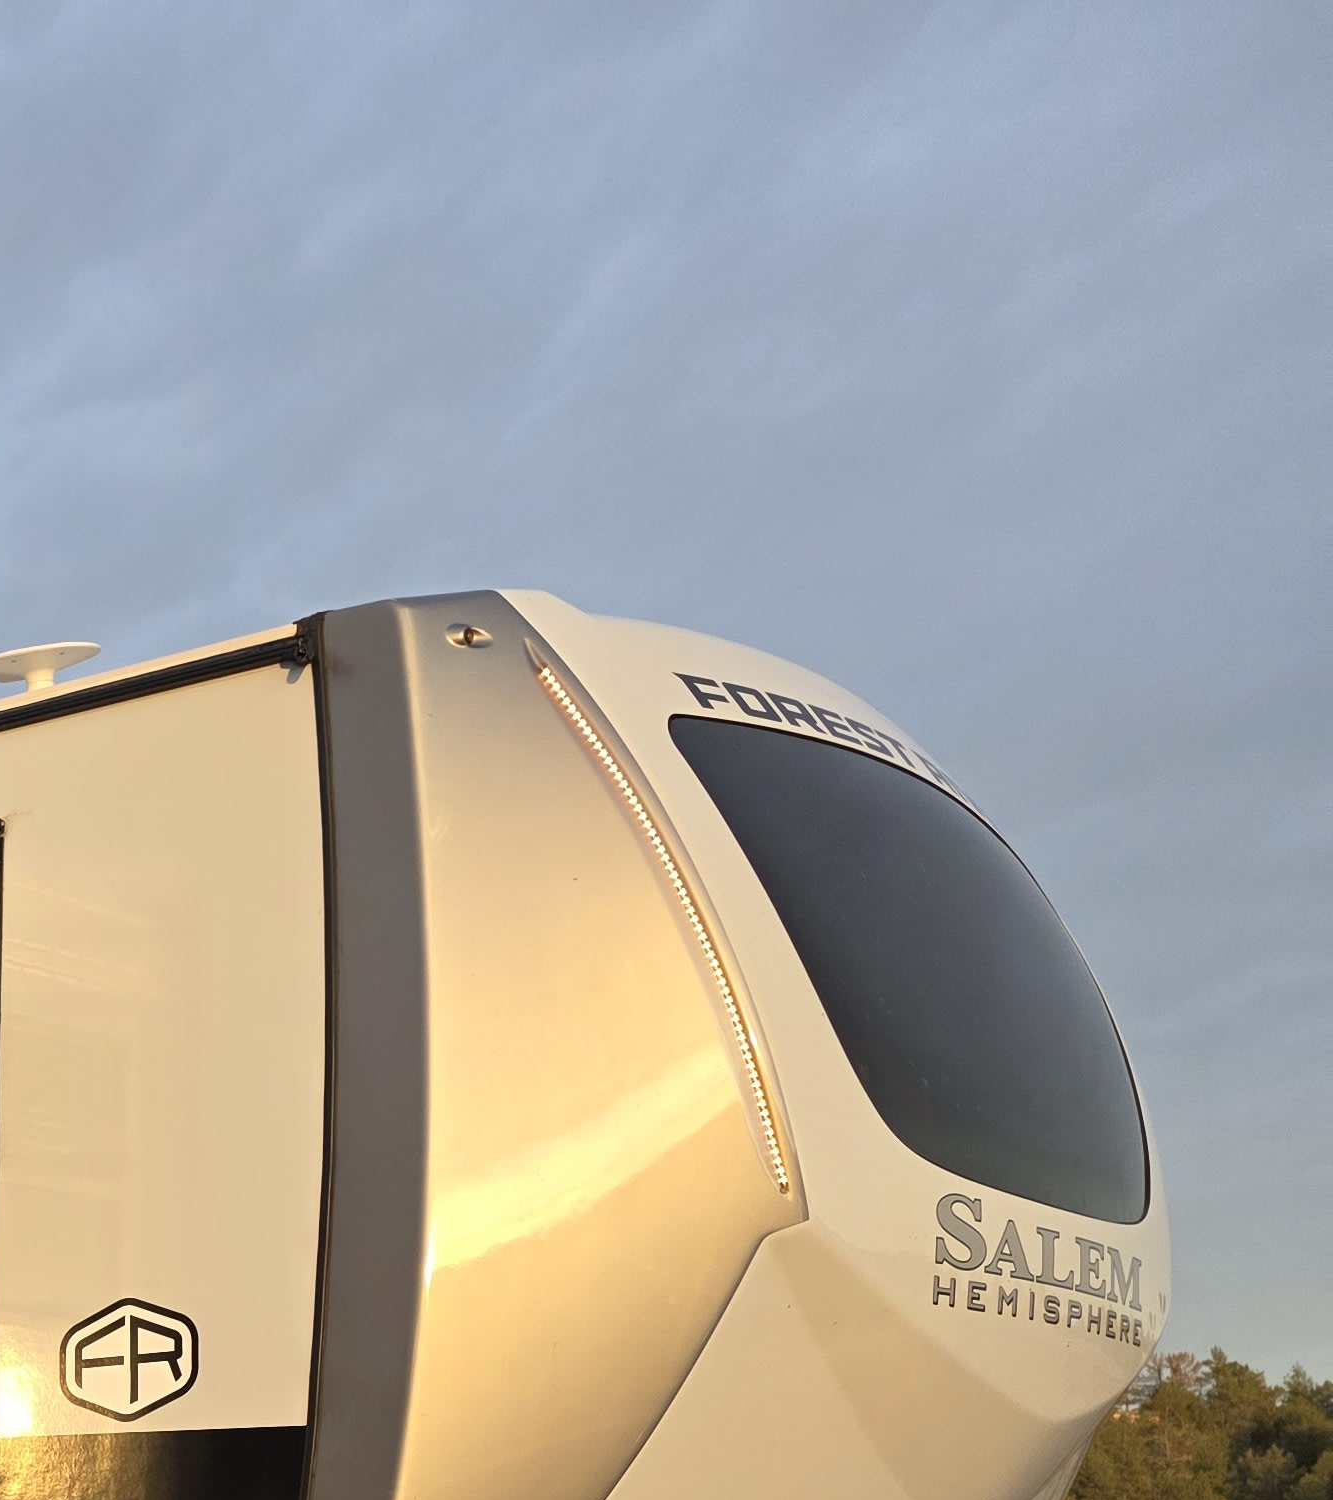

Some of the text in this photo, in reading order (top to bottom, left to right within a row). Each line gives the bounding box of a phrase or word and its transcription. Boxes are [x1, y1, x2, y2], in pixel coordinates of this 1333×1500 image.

[673, 672, 916, 769] FOREST
[935, 1193, 1142, 1312] SALEM
[932, 1275, 1142, 1347] HEMISPHERE
